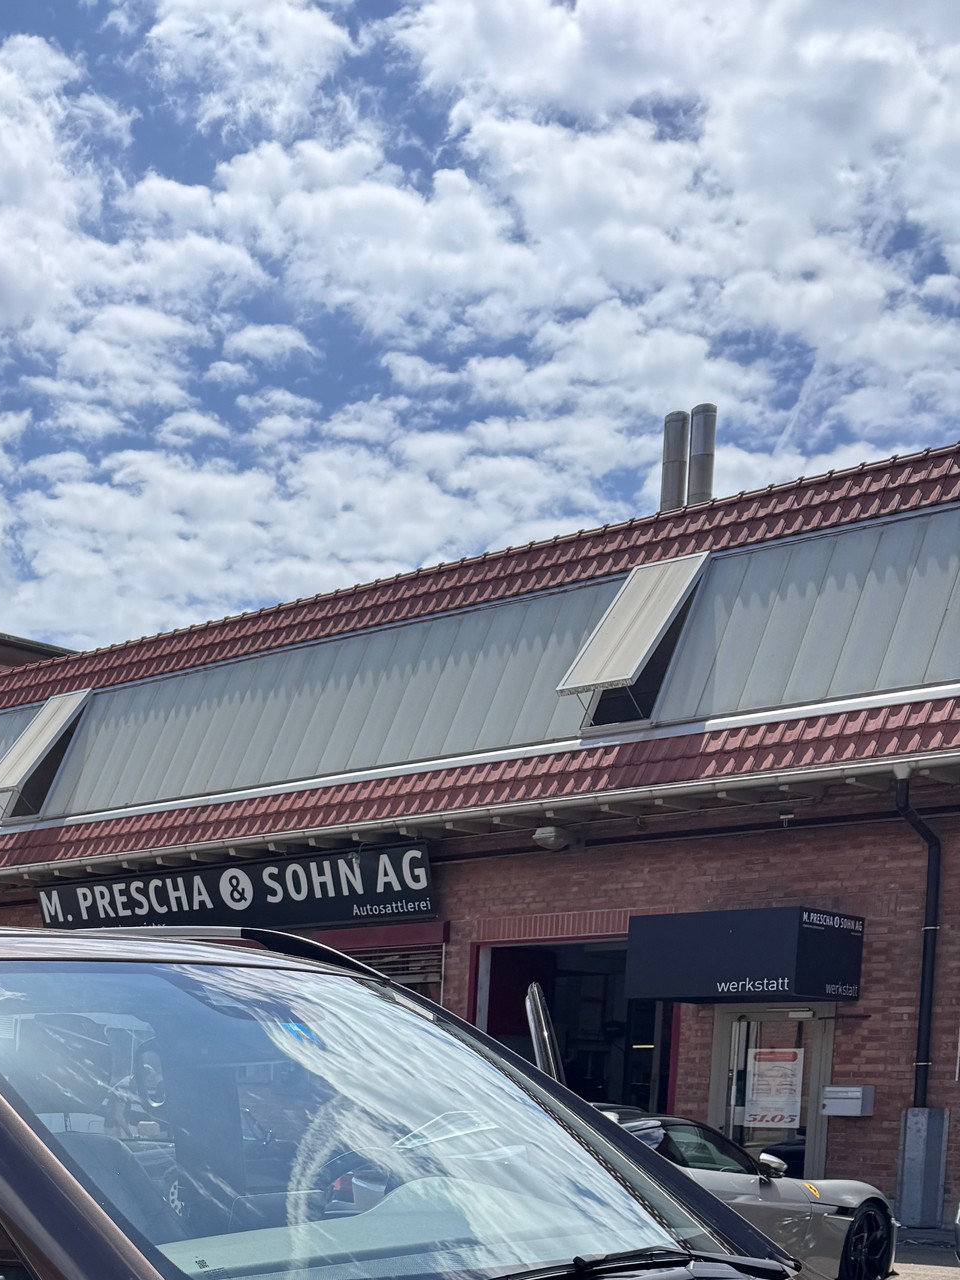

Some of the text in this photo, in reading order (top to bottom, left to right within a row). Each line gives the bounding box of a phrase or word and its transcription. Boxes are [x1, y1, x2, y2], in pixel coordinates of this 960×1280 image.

[40, 890, 73, 923] M.
[77, 876, 214, 920] PRESCHA
[262, 858, 364, 903] SOHN
[376, 849, 428, 893] AG
[353, 897, 431, 916] Autosattlerei
[802, 911, 810, 922] M.
[810, 912, 834, 927] PRESCHA
[716, 977, 790, 992] werkstatt
[825, 982, 858, 997] werkstatt
